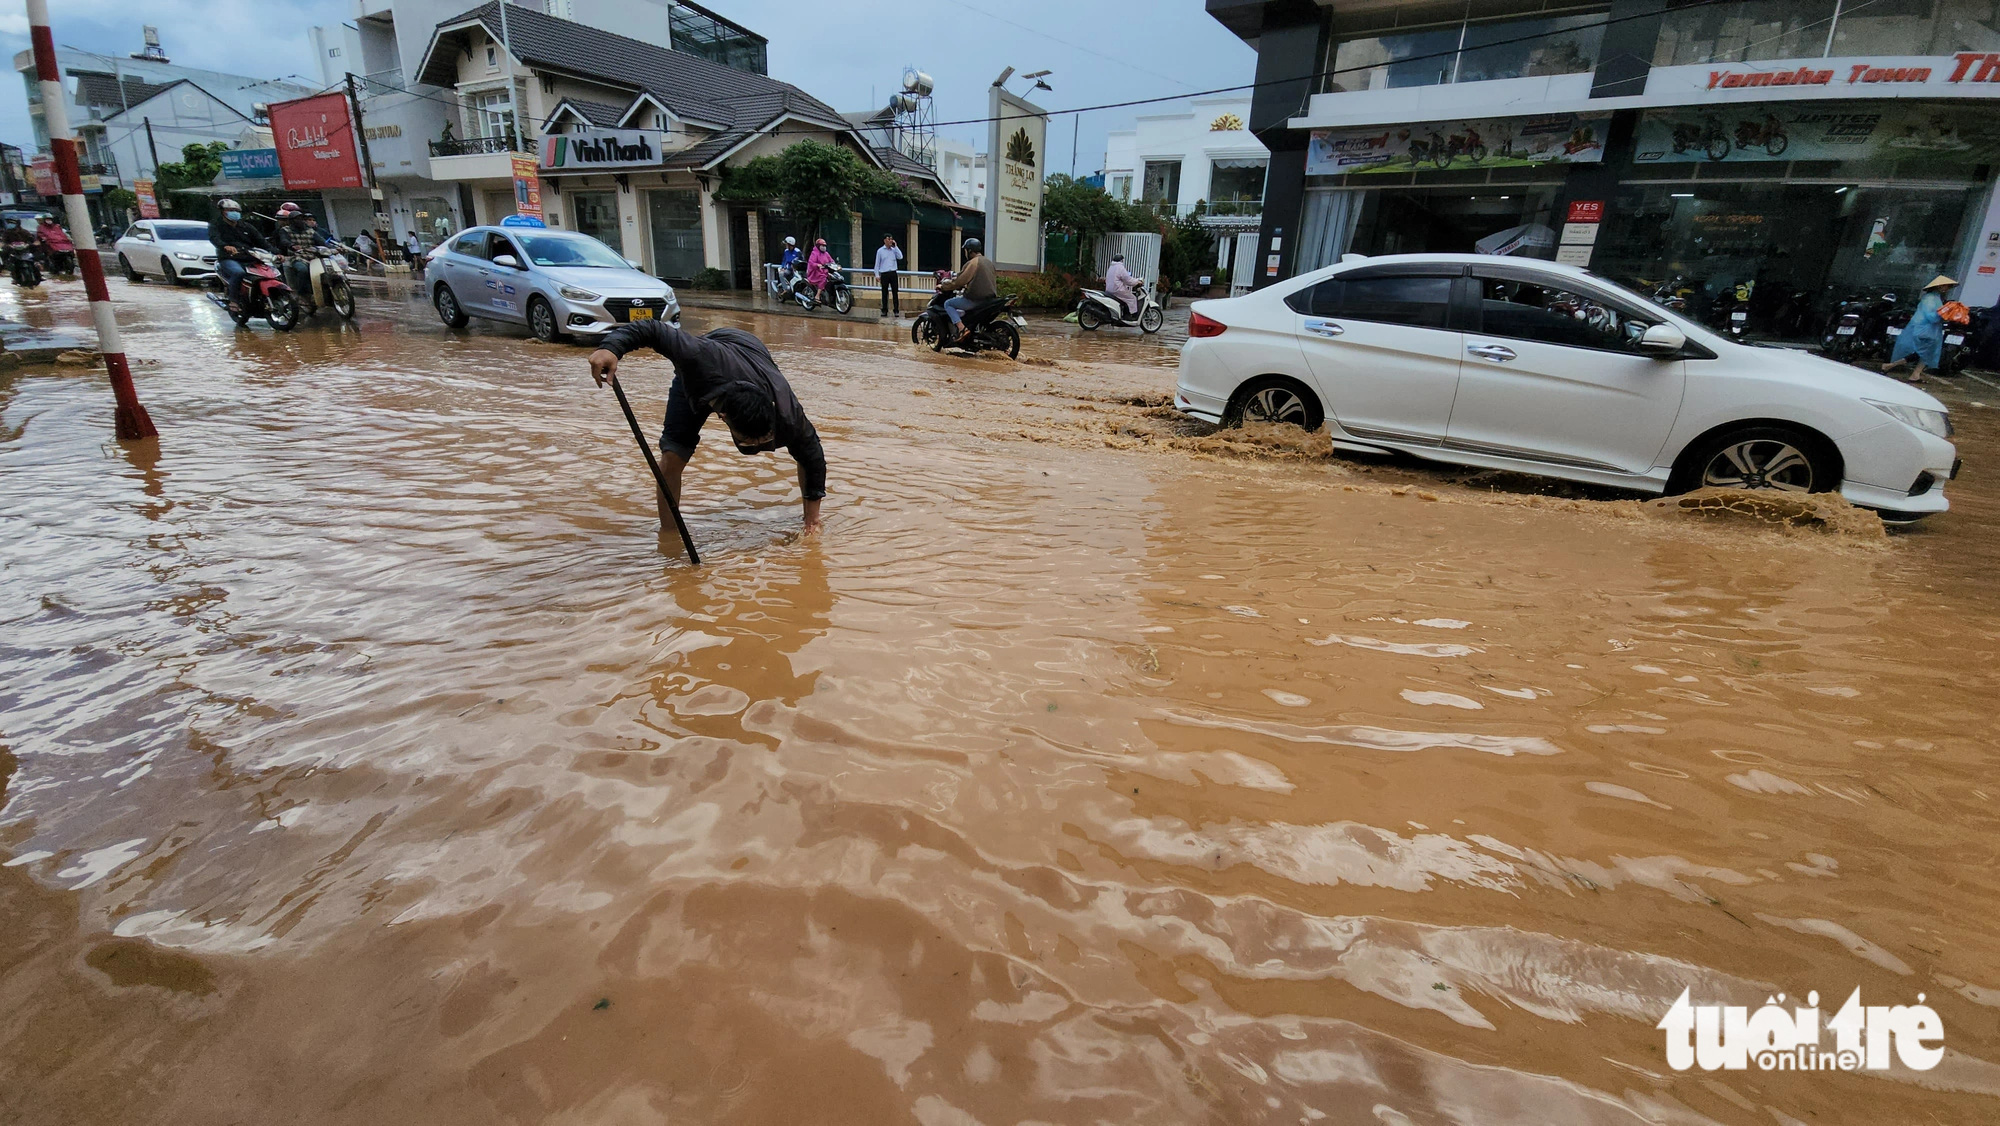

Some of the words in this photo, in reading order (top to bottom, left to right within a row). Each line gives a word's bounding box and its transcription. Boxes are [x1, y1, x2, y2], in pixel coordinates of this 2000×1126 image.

[1707, 67, 1835, 90] Yamaha
[1848, 64, 1932, 84] Town
[1576, 203, 1598, 211] YES
